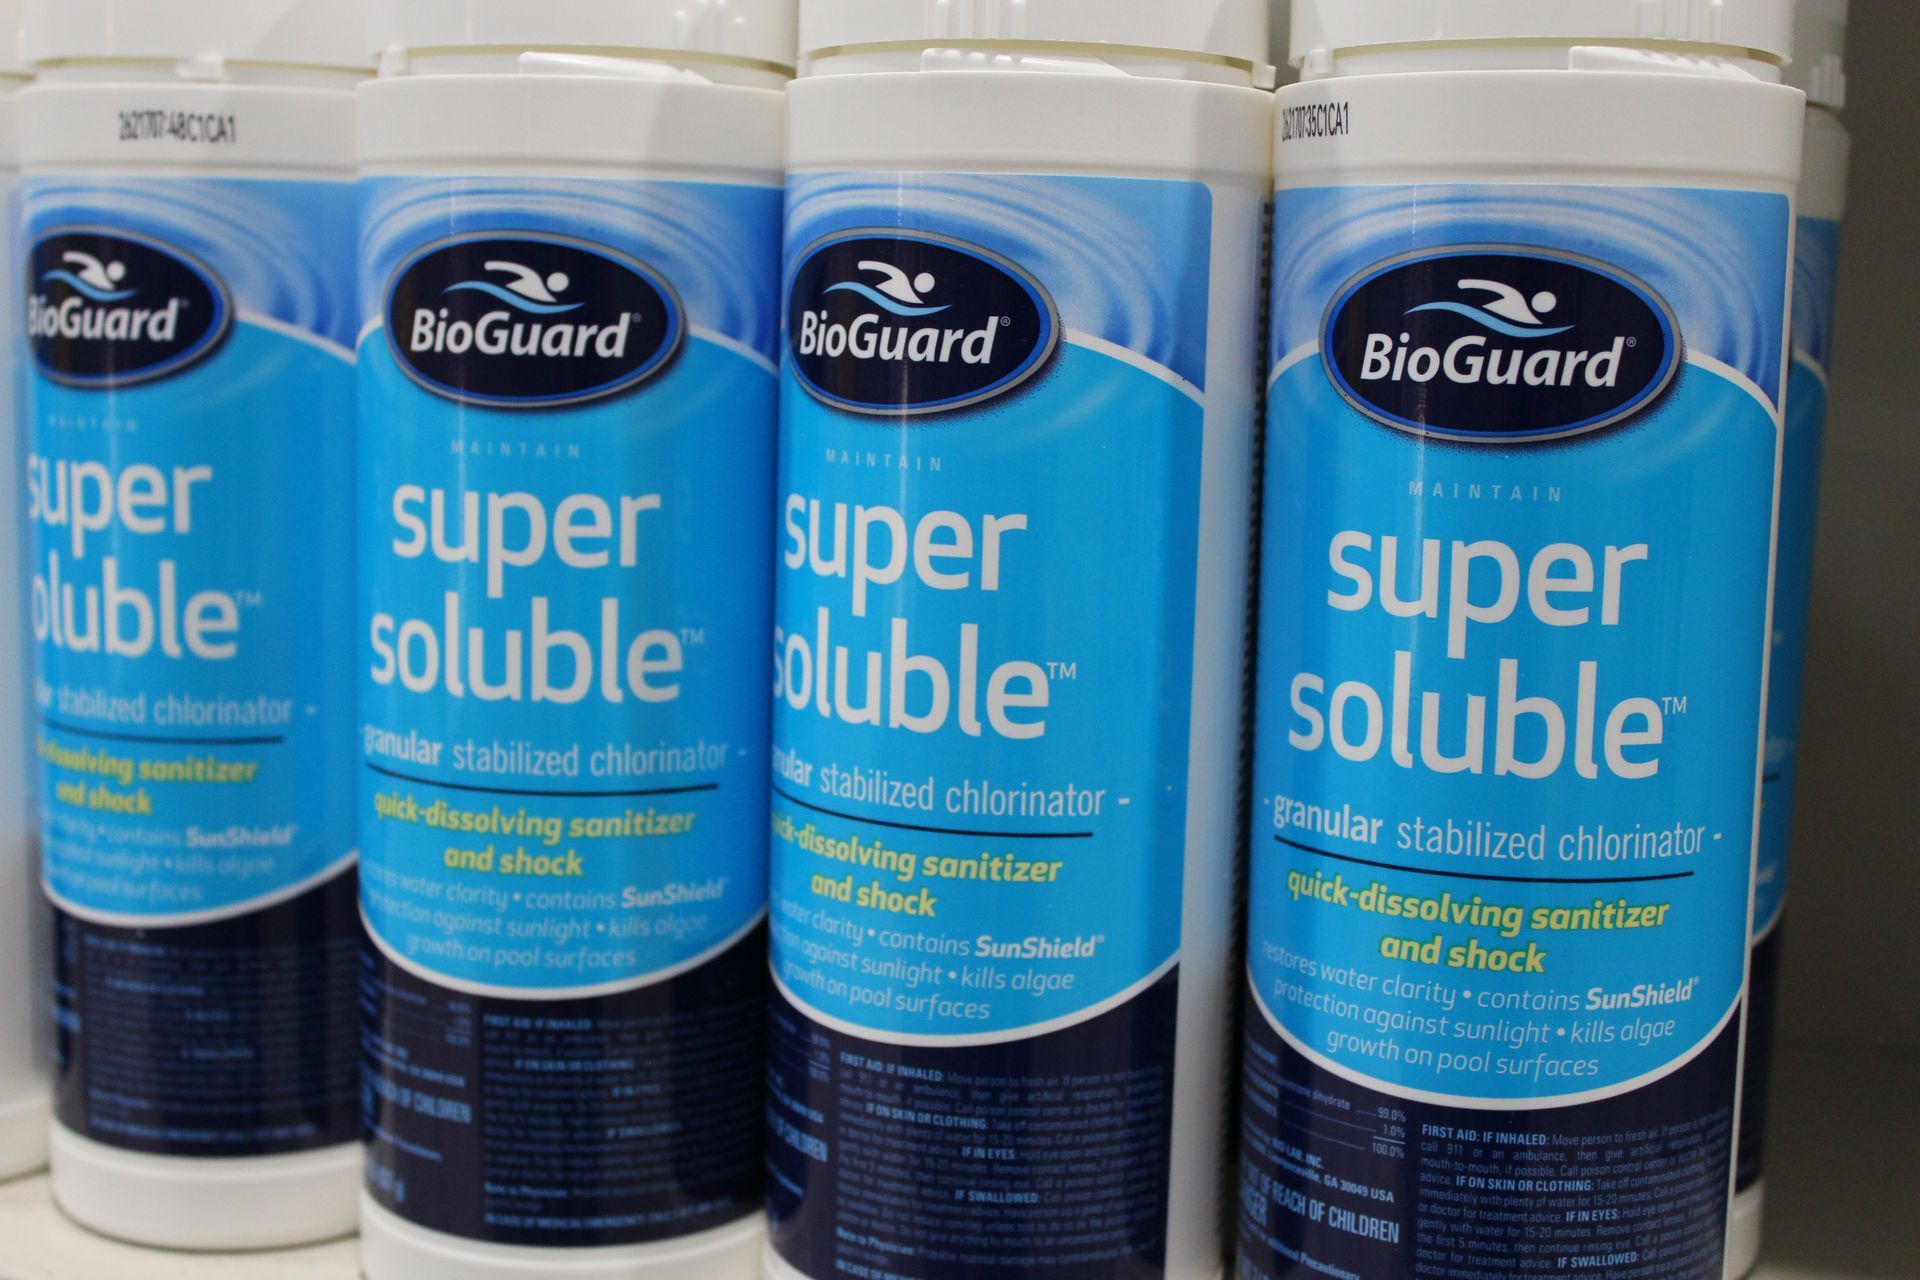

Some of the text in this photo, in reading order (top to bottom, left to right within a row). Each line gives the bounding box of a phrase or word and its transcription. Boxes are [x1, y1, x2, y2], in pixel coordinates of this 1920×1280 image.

[451, 439, 580, 458] MAINTAIN
[825, 448, 942, 472] MAINTAIN
[1409, 480, 1562, 502] MAINTAIN
[392, 484, 661, 598] super
[784, 493, 1028, 617] super
[1327, 530, 1648, 659] super
[452, 740, 579, 777] stabilized
[590, 742, 728, 776] chlorinator
[819, 763, 934, 811] stabilized
[946, 779, 1106, 817] chlorinator
[375, 791, 696, 846] quick-dissolving sanitizer
[1273, 794, 1705, 861] granular stabilized chlorinator
[443, 845, 584, 877] and shock
[922, 853, 1063, 883] sanitizer
[525, 888, 617, 909] contains
[811, 873, 852, 902] and
[856, 880, 937, 917] shock
[1287, 870, 1670, 938] quick-dissolving sanitizer
[506, 920, 589, 945] sunlight
[811, 910, 864, 947] clarity
[879, 929, 969, 957] contains
[494, 947, 540, 969] pool
[545, 946, 637, 971] surfaces
[1381, 935, 1547, 973] and shock
[861, 955, 942, 988] sunlight
[961, 967, 1006, 990] kills
[1011, 970, 1075, 996] algae
[1321, 964, 1378, 992] water
[1382, 974, 1456, 1011] clarity
[1478, 988, 1580, 1011] contains
[850, 982, 893, 1010] pool
[895, 991, 990, 1021] surfaces
[1274, 979, 1676, 1049] protection against sunlight kills algae
[1327, 1030, 1600, 1081] growth on pool surfaces
[1377, 1107, 1406, 1122] 99.0%
[1383, 1124, 1405, 1138] 1.0%
[1422, 1124, 1612, 1146] FIRST AID: IF INHALED: Move person
[1372, 1142, 1404, 1158] 100.0%
[1421, 1142, 1438, 1151] call
[1447, 1144, 1463, 1155] 911
[1456, 1176, 1466, 1186] IF
[1468, 1177, 1485, 1188] ON
[1488, 1179, 1515, 1191] SKIN
[1518, 1181, 1533, 1191] OR
[1535, 1180, 1594, 1192] CLOTHING:
[1560, 1165, 1578, 1177] Call
[1371, 1189, 1395, 1203] USA
[1309, 1199, 1325, 1222] OF
[1328, 1206, 1400, 1244] CHILDREN
[1566, 1212, 1576, 1222] IF
[1578, 1211, 1590, 1222] IN
[1592, 1209, 1620, 1221] EYES:
[1557, 1258, 1567, 1268] IF
[1571, 1252, 1639, 1268] SWALLOWED:
